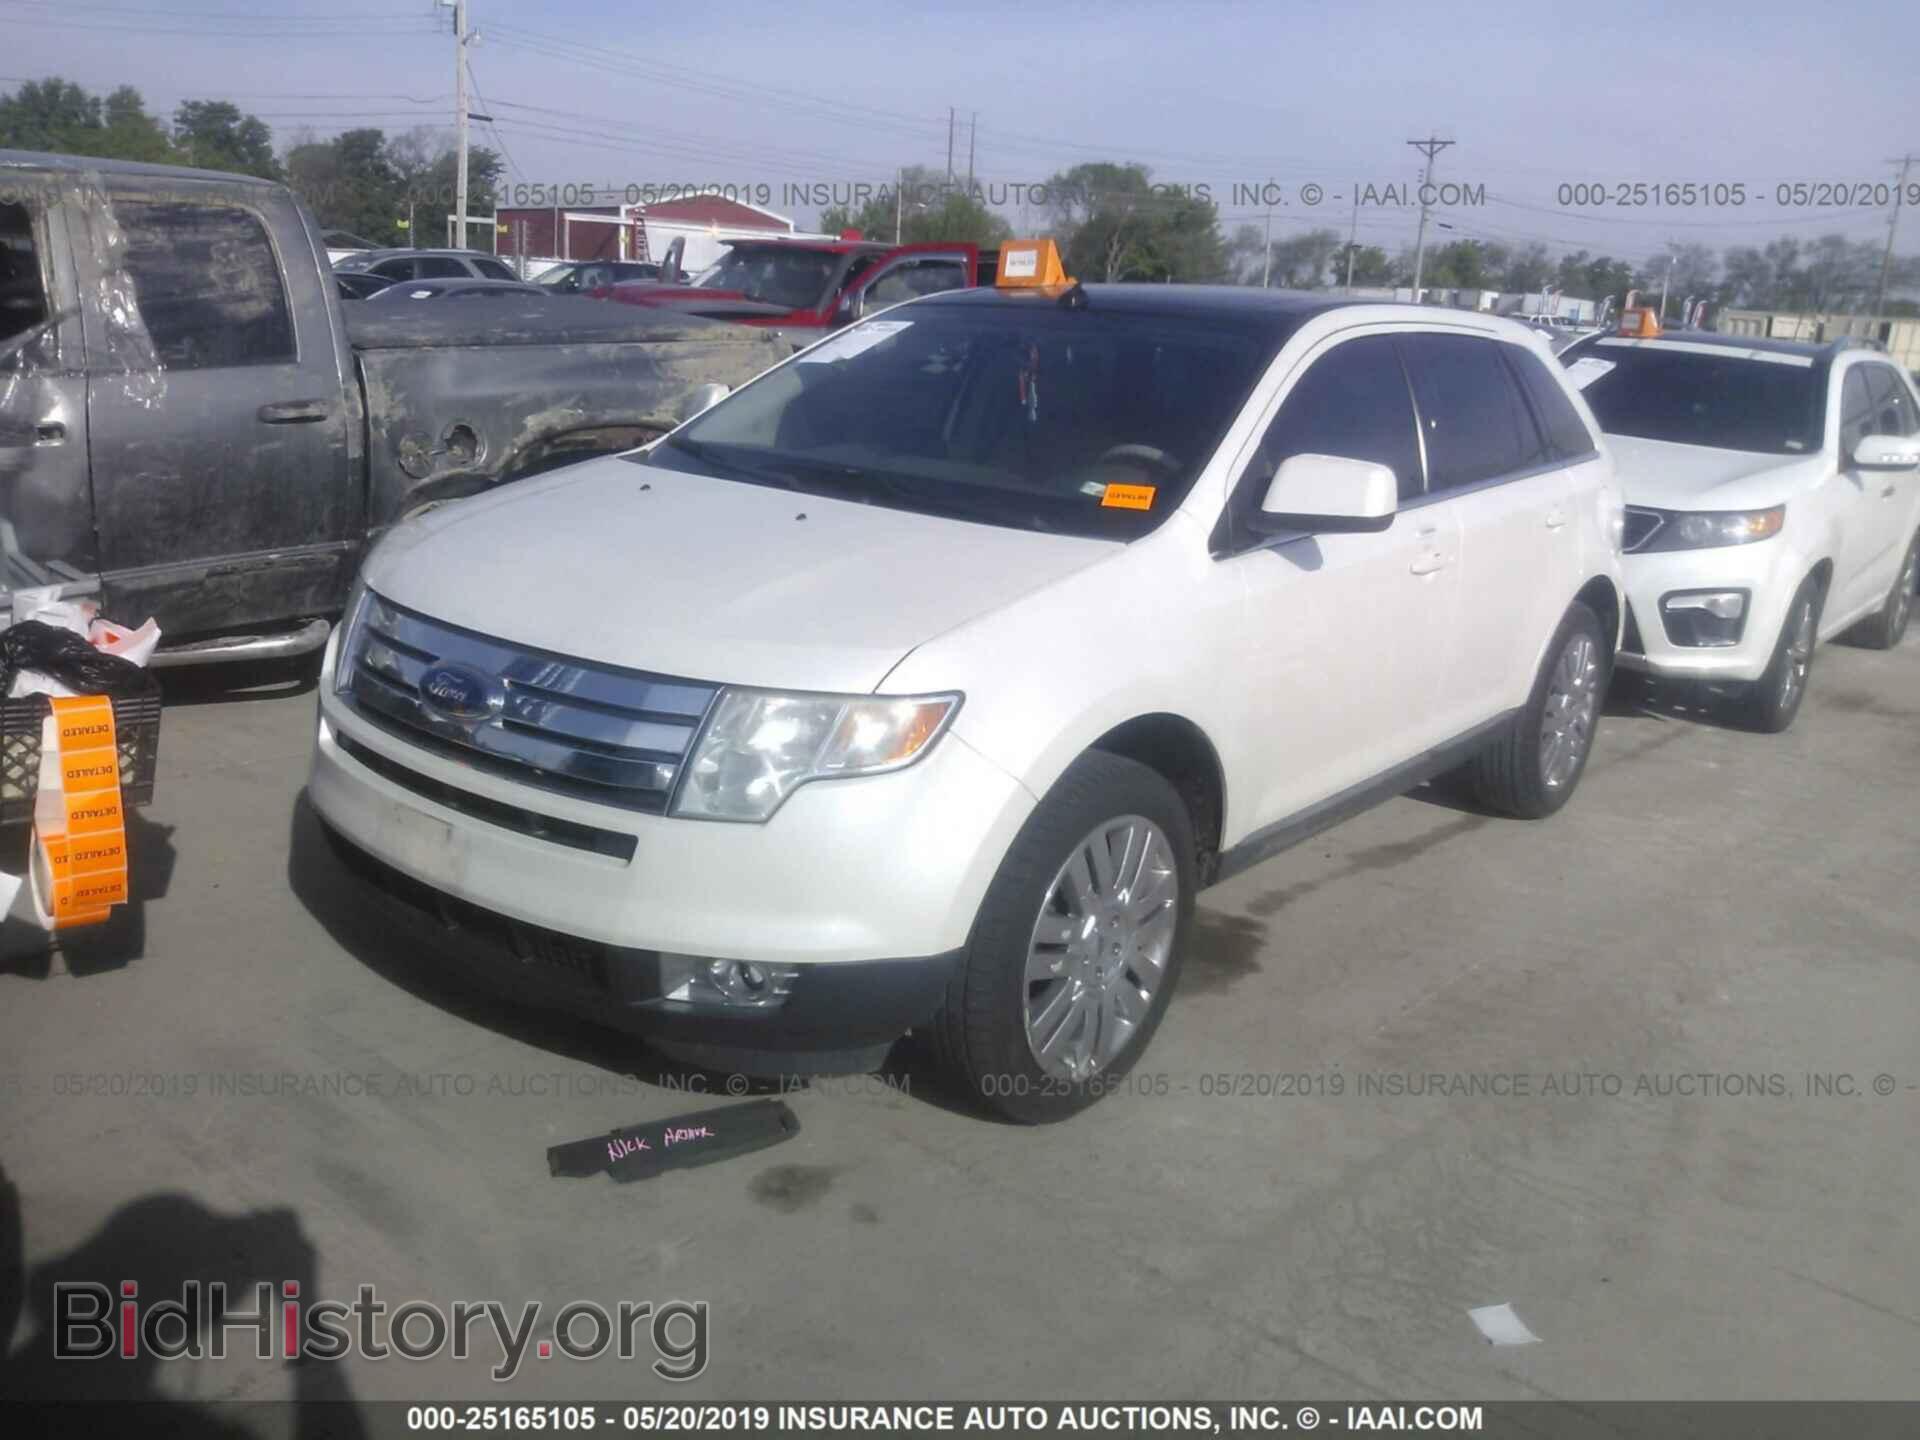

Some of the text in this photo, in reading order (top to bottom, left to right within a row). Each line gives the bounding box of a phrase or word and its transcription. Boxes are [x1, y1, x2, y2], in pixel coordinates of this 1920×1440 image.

[63, 724, 110, 737] DETAILED
[66, 765, 114, 779] DETAILED
[71, 807, 118, 820] DETAILED
[74, 846, 121, 861] DETAILED
